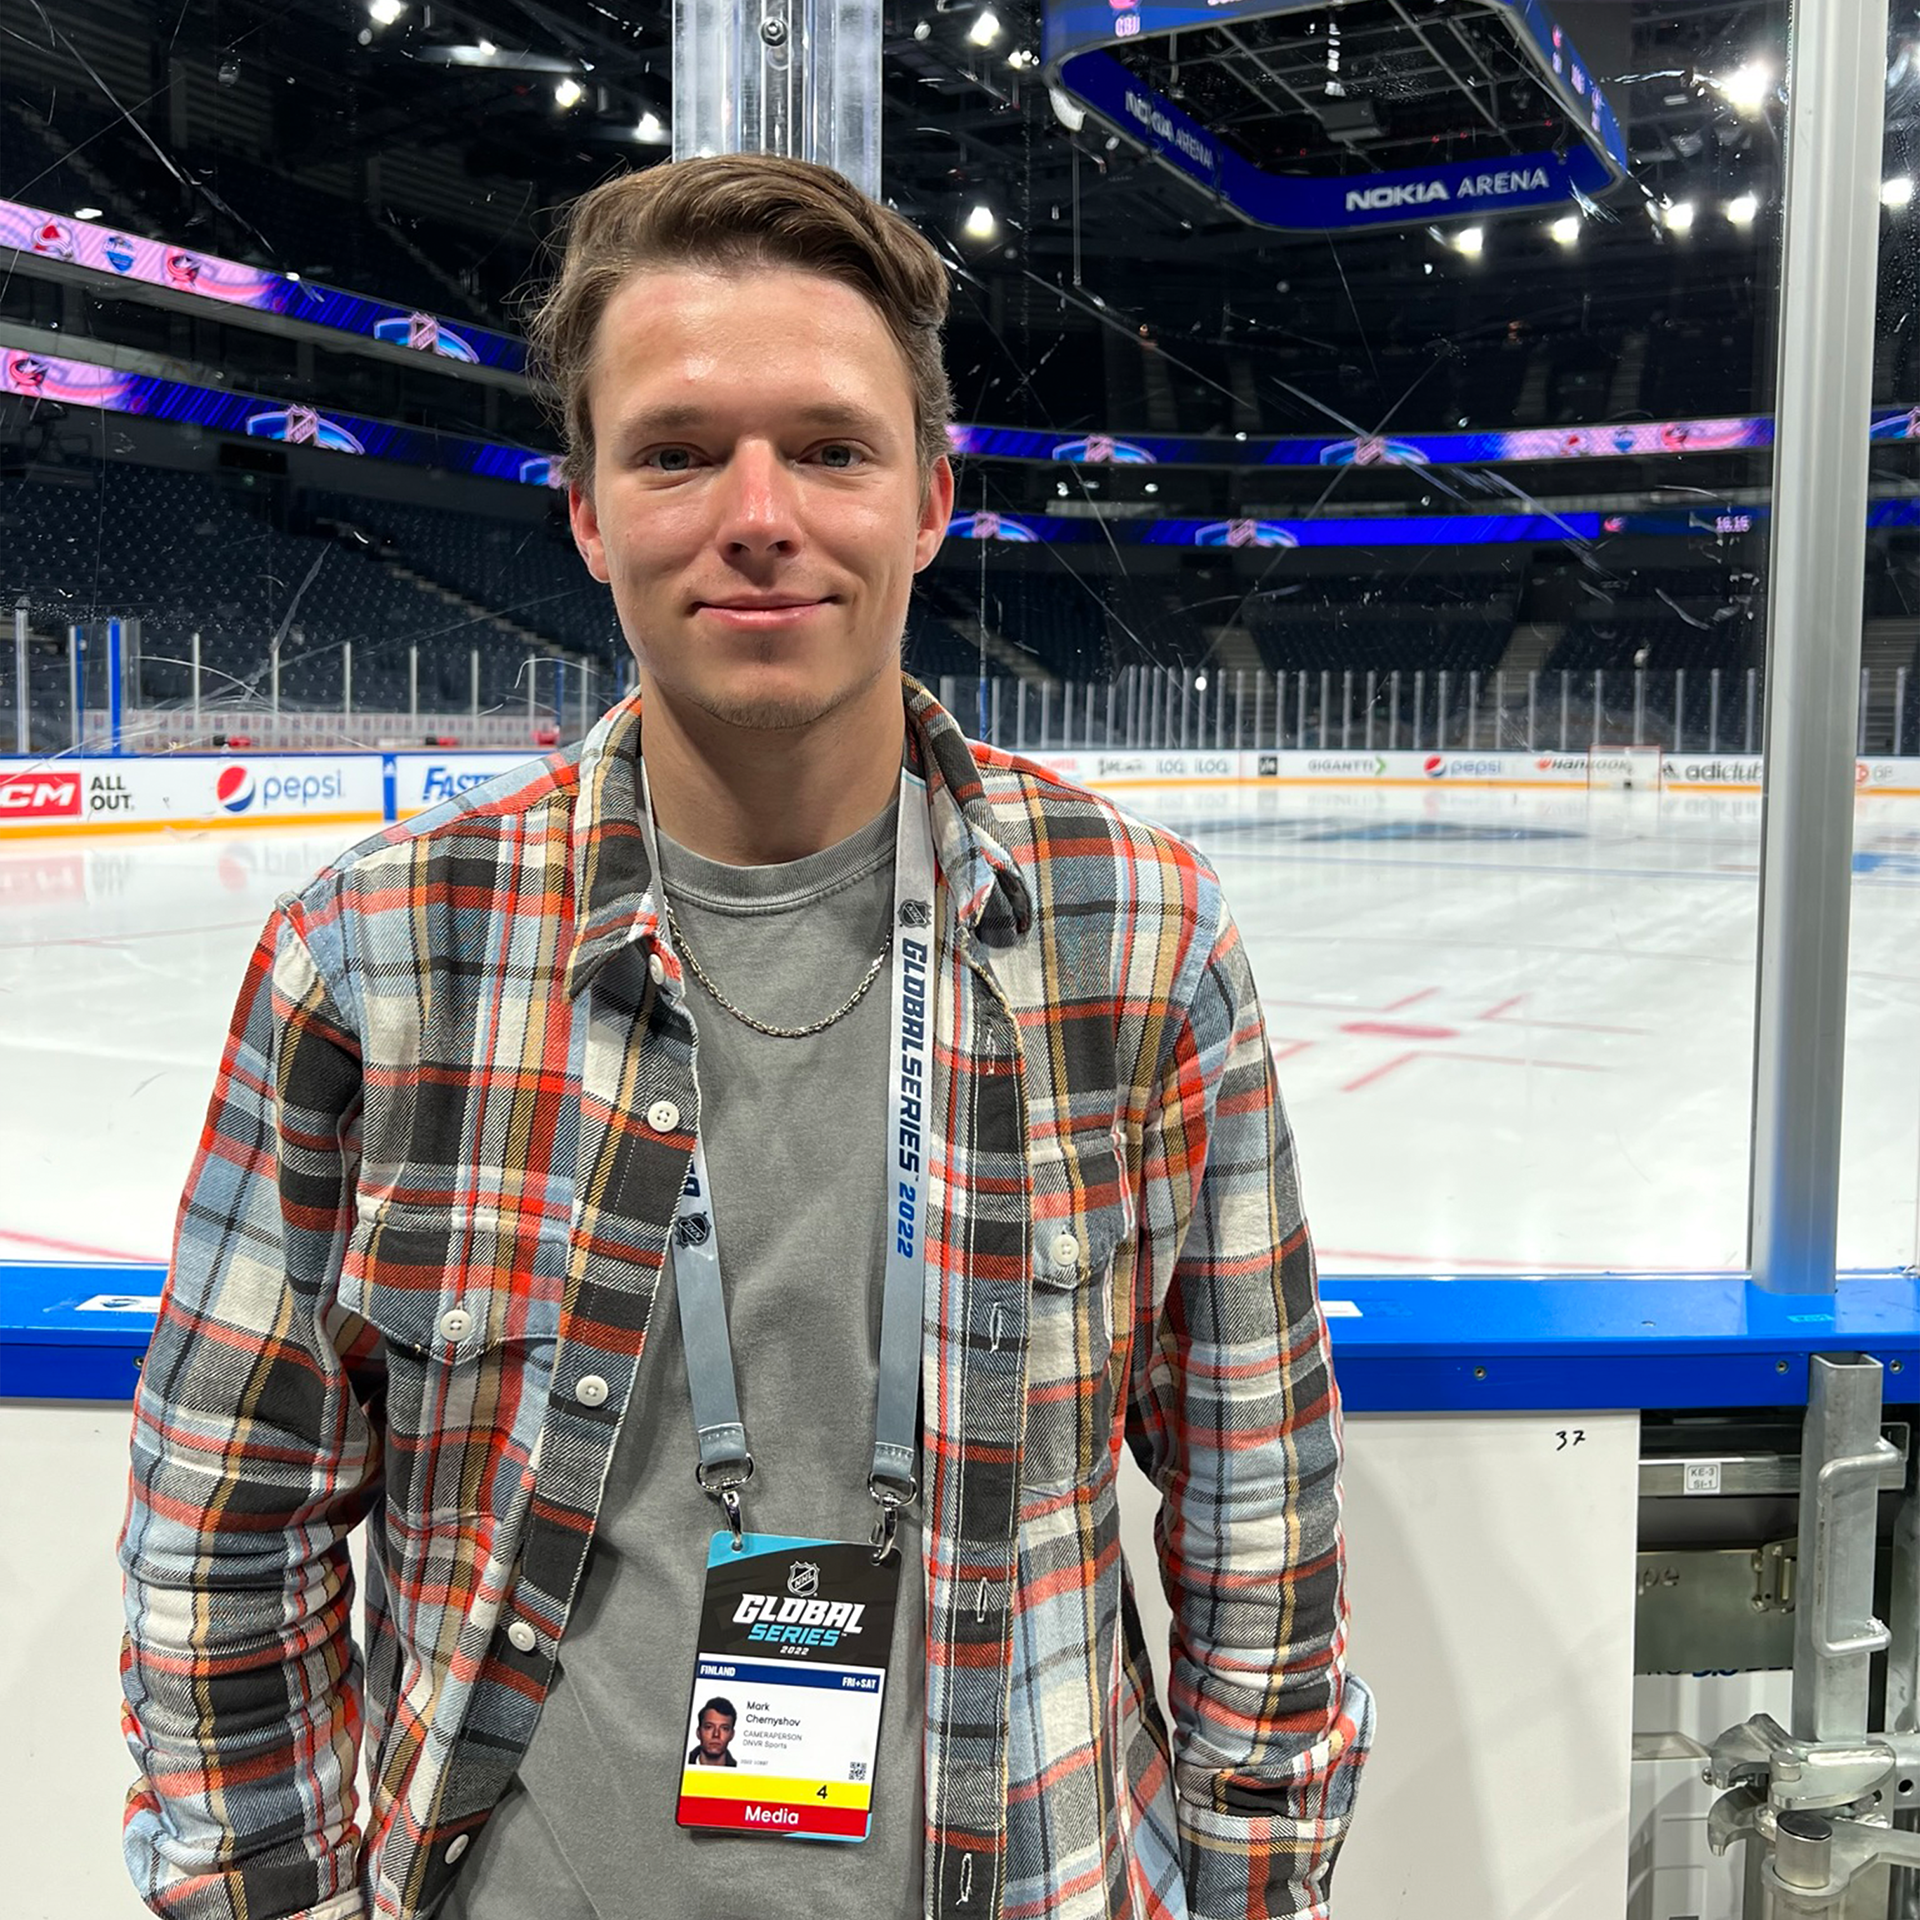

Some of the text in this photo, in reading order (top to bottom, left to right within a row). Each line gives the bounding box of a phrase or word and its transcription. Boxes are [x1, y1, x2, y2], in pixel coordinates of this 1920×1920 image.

[1125, 90, 1215, 171] NOKIA ARENA
[1345, 166, 1549, 211] NOKIA ARENA
[1450, 760, 1501, 775] pepsi
[90, 776, 126, 791] ALL
[263, 769, 342, 808] pepsi
[898, 1181, 916, 1259] 2022
[1555, 1430, 1586, 1451] 37
[1690, 1467, 1715, 1477] KE-3
[794, 1570, 815, 1588] NHL
[732, 1593, 866, 1634] GLOBAL
[780, 1645, 810, 1656] 2022
[700, 1664, 877, 1690] FINLAND FRI+SAT
[746, 1701, 770, 1711] Mark
[745, 1714, 801, 1727] Chernyshov
[743, 1730, 802, 1741] CAMERAPERSON
[764, 1741, 787, 1749] Sports
[816, 1785, 828, 1800] 4
[744, 1806, 799, 1824] Media
